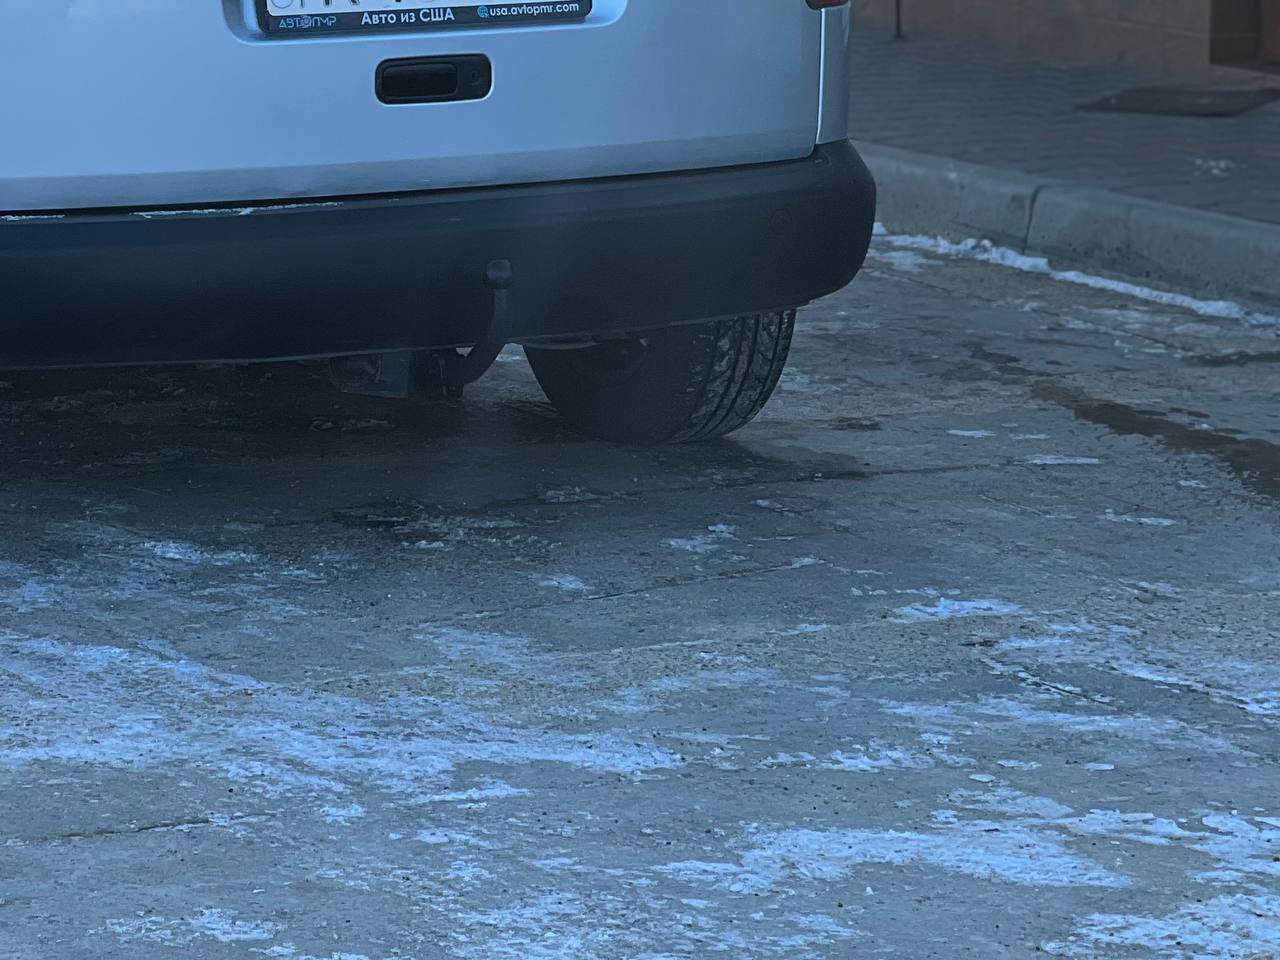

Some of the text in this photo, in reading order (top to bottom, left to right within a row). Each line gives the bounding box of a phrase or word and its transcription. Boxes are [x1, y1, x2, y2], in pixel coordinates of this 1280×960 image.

[361, 7, 455, 25] Авто из США
[489, 2, 580, 18] usa.avtopmr.com
